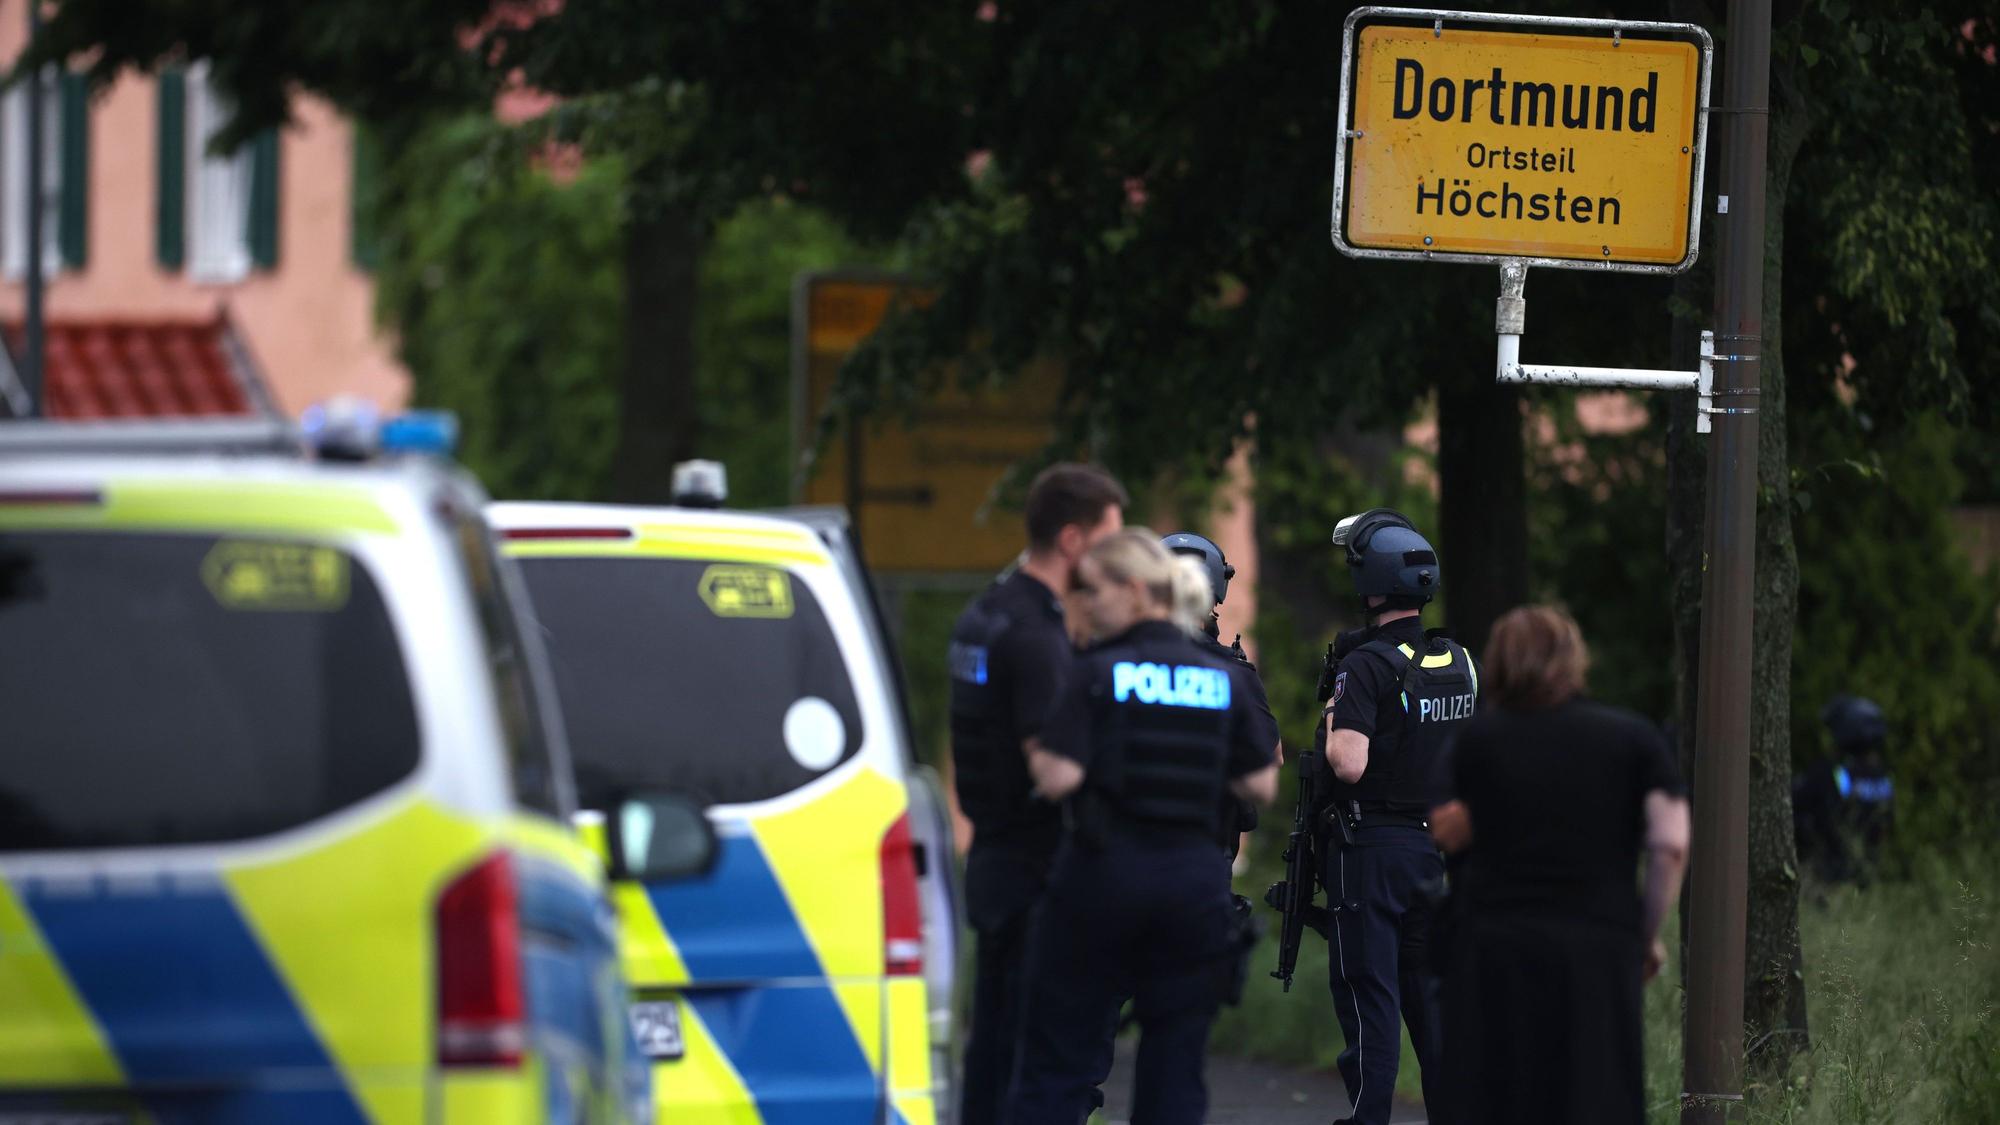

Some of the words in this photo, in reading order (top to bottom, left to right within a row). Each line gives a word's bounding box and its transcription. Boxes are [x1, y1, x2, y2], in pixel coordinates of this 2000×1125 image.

[1393, 58, 1658, 133] Dortmund
[1467, 142, 1576, 173] Ortsteil
[1416, 177, 1621, 225] Höchsten
[1113, 661, 1230, 710] POLIZEI
[1420, 693, 1475, 723] POLIZEI
